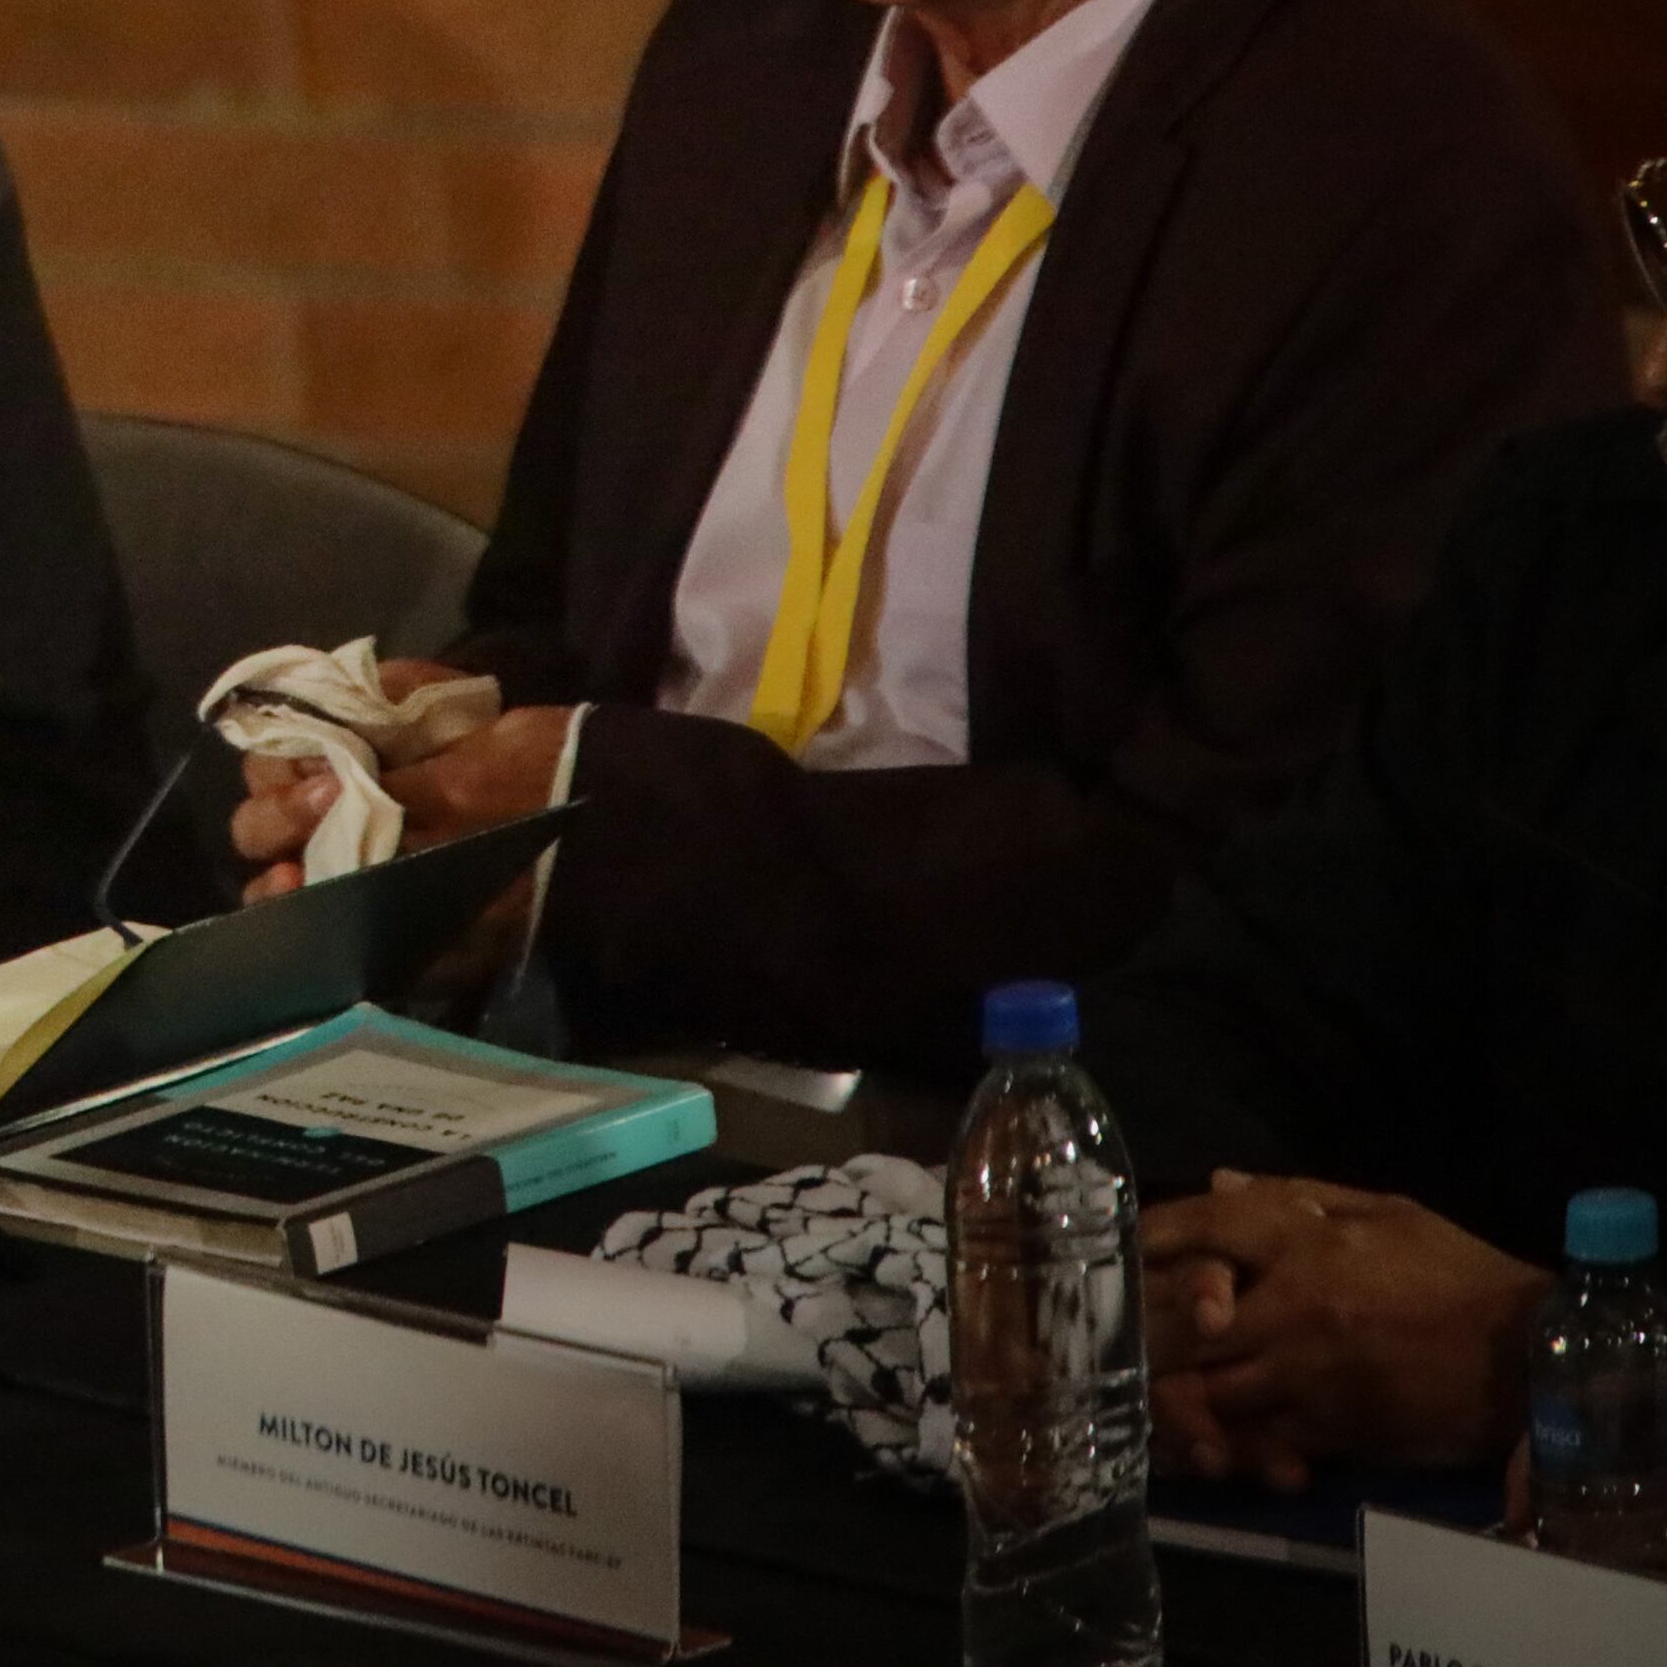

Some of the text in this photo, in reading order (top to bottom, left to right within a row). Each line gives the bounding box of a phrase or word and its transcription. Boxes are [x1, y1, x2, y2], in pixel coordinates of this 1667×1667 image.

[258, 1412, 578, 1518] MILTON DE JESÚS TONCEL
